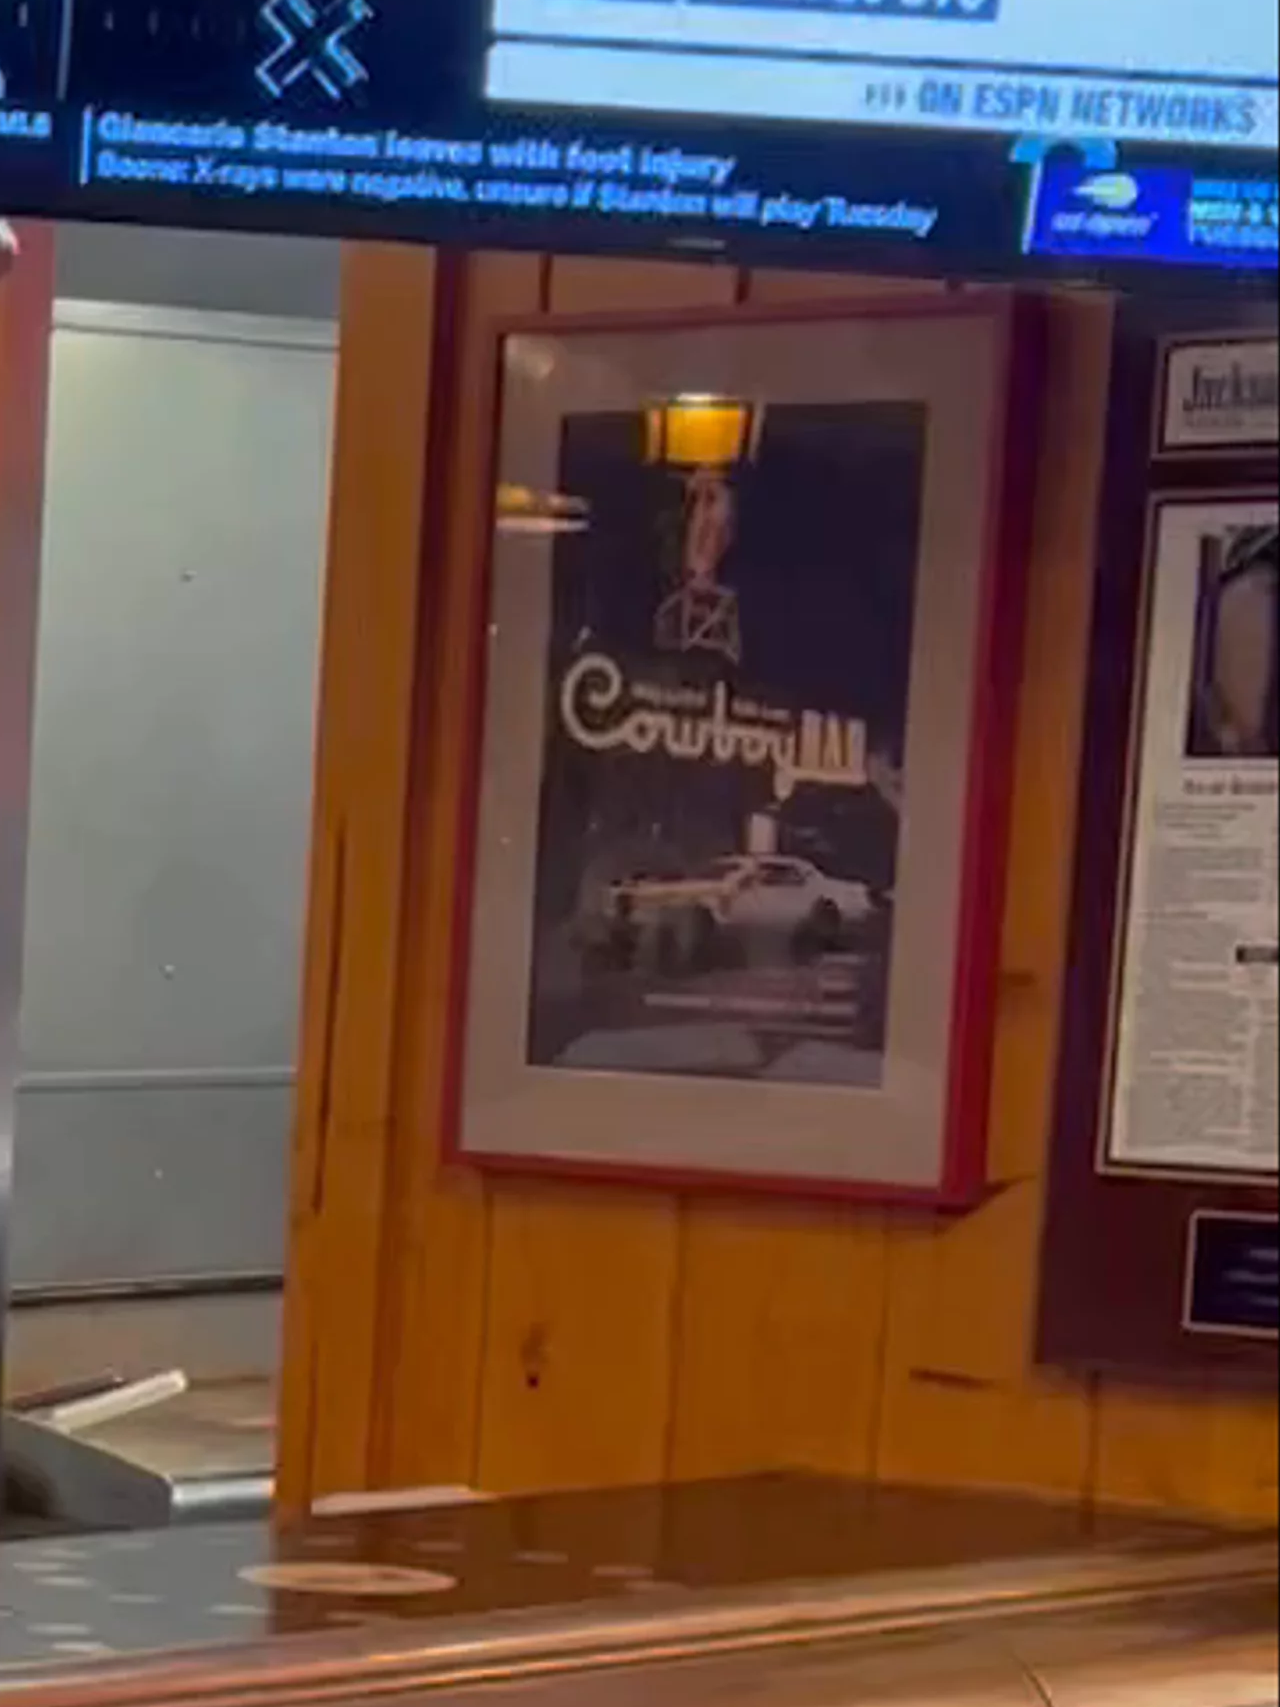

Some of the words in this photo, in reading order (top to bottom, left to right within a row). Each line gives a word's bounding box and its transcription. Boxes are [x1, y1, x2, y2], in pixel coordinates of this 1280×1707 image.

[917, 81, 964, 116] ON
[973, 84, 1060, 122] ESPN
[1072, 90, 1256, 134] NETWORKS
[490, 140, 558, 170] with
[561, 653, 797, 800] Cowboy
